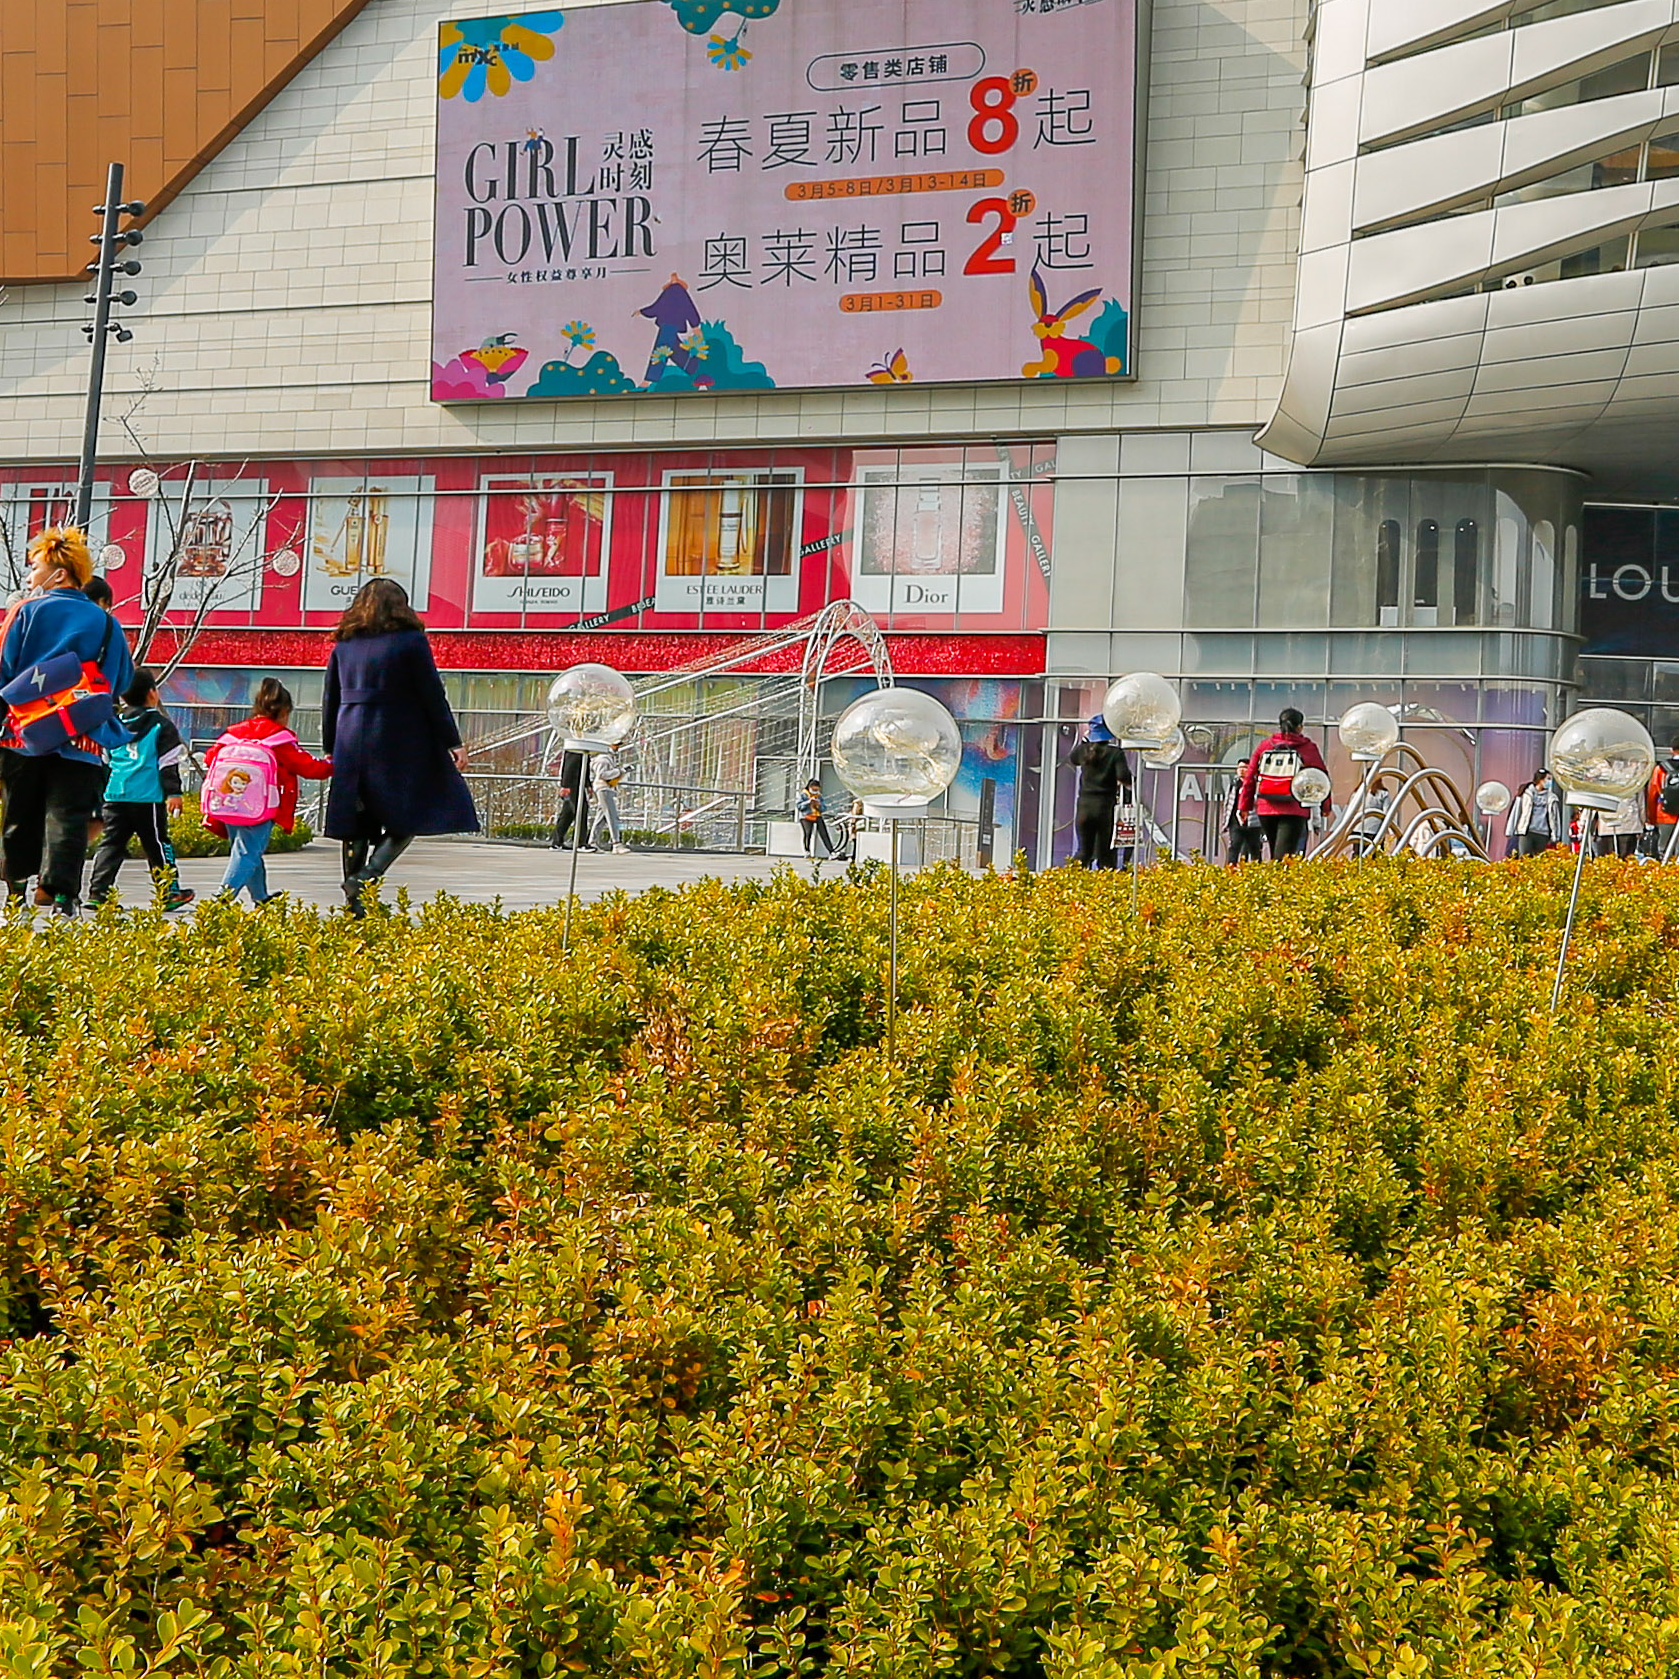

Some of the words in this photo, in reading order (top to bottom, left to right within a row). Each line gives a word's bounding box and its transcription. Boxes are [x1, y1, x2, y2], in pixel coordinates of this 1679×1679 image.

[839, 53, 948, 82] 零售类店铺
[601, 128, 654, 162] 灵感
[465, 135, 596, 204] GIRL
[599, 160, 653, 193] 时刻
[463, 195, 658, 267] POWER
[506, 266, 607, 285] 女性权益尊享月
[845, 293, 934, 313] 3月1-31日
[1011, 489, 1035, 527] BEAUTY
[506, 585, 571, 598] SHISEIDO
[721, 585, 763, 595] LAUDER
[905, 584, 949, 604] Dior
